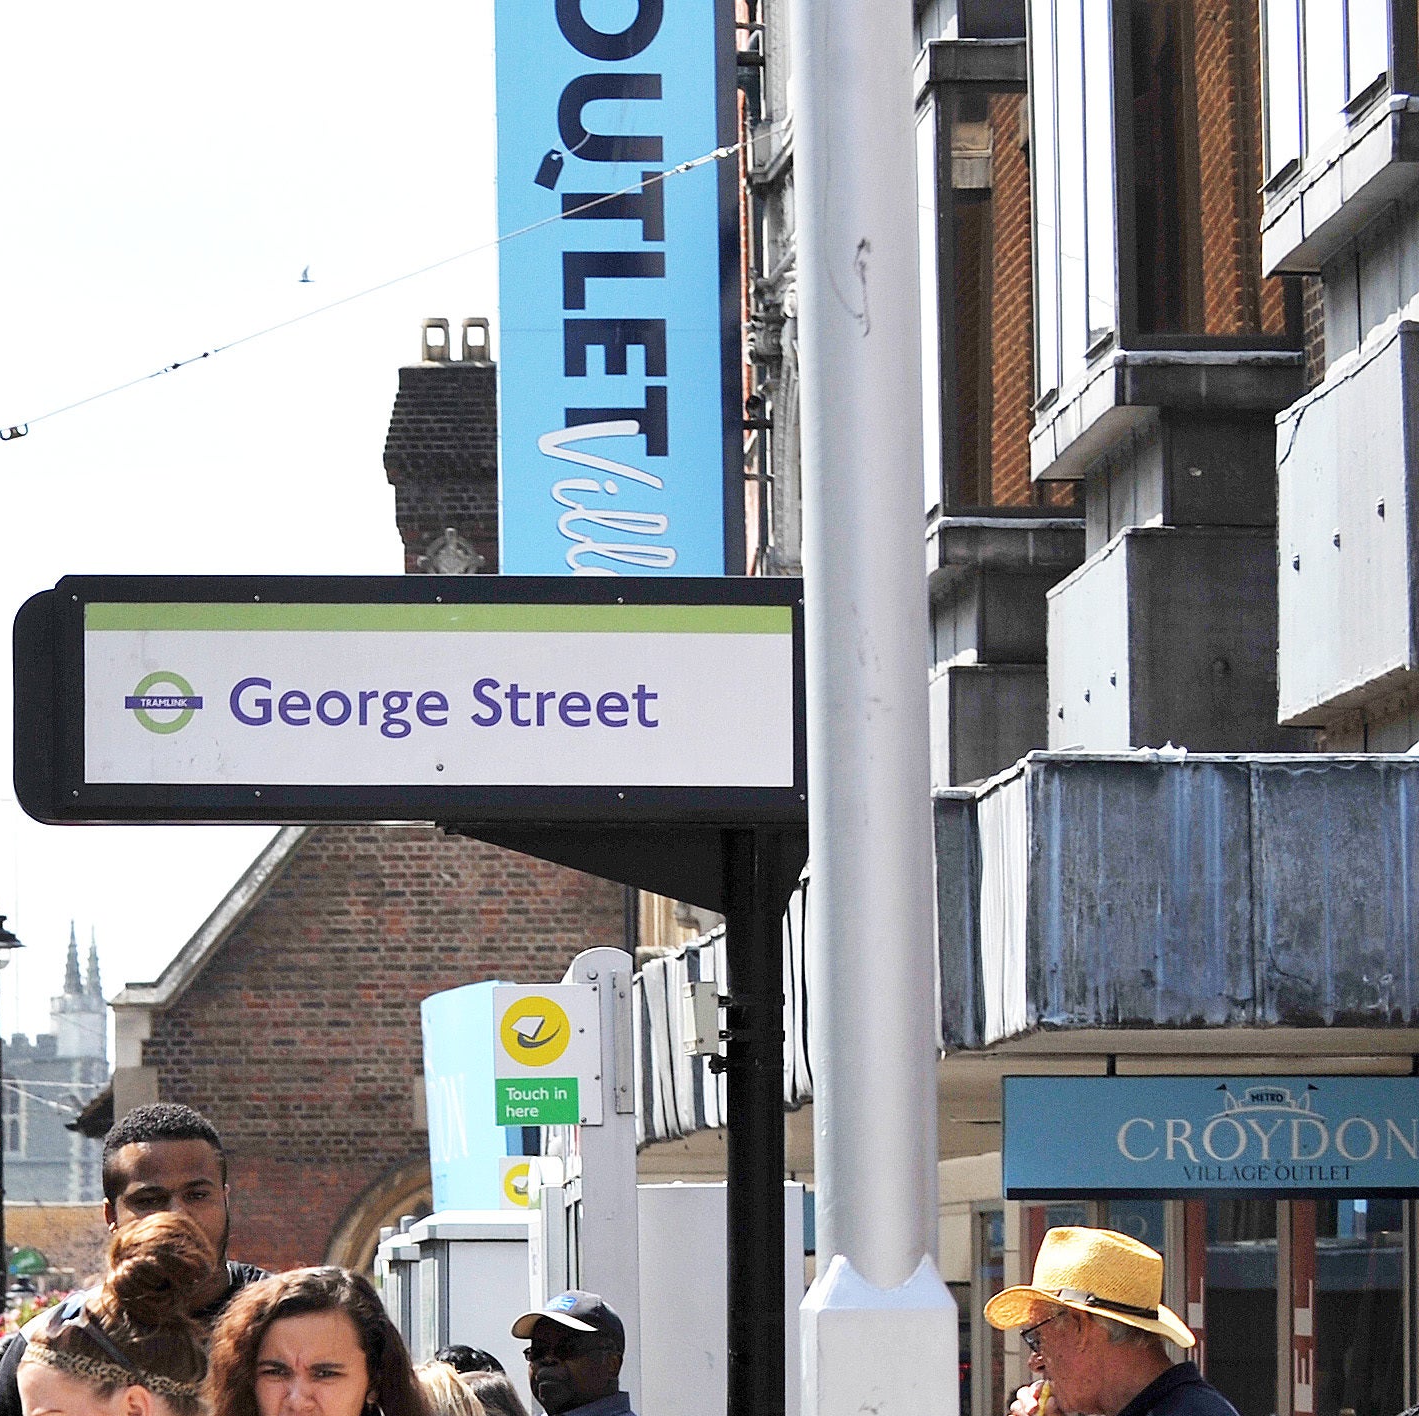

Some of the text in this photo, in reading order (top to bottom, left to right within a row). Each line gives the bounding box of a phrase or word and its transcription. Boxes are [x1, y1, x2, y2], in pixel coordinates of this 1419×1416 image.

[139, 698, 188, 708] TRAMLINK
[229, 677, 659, 739] George Street
[505, 1086, 568, 1101] Touch in
[1250, 1092, 1284, 1103] METRO
[505, 1104, 539, 1118] here
[1116, 1117, 1419, 1163] CROYDON
[1182, 1163, 1355, 1182] VILLAGE OUTLET
